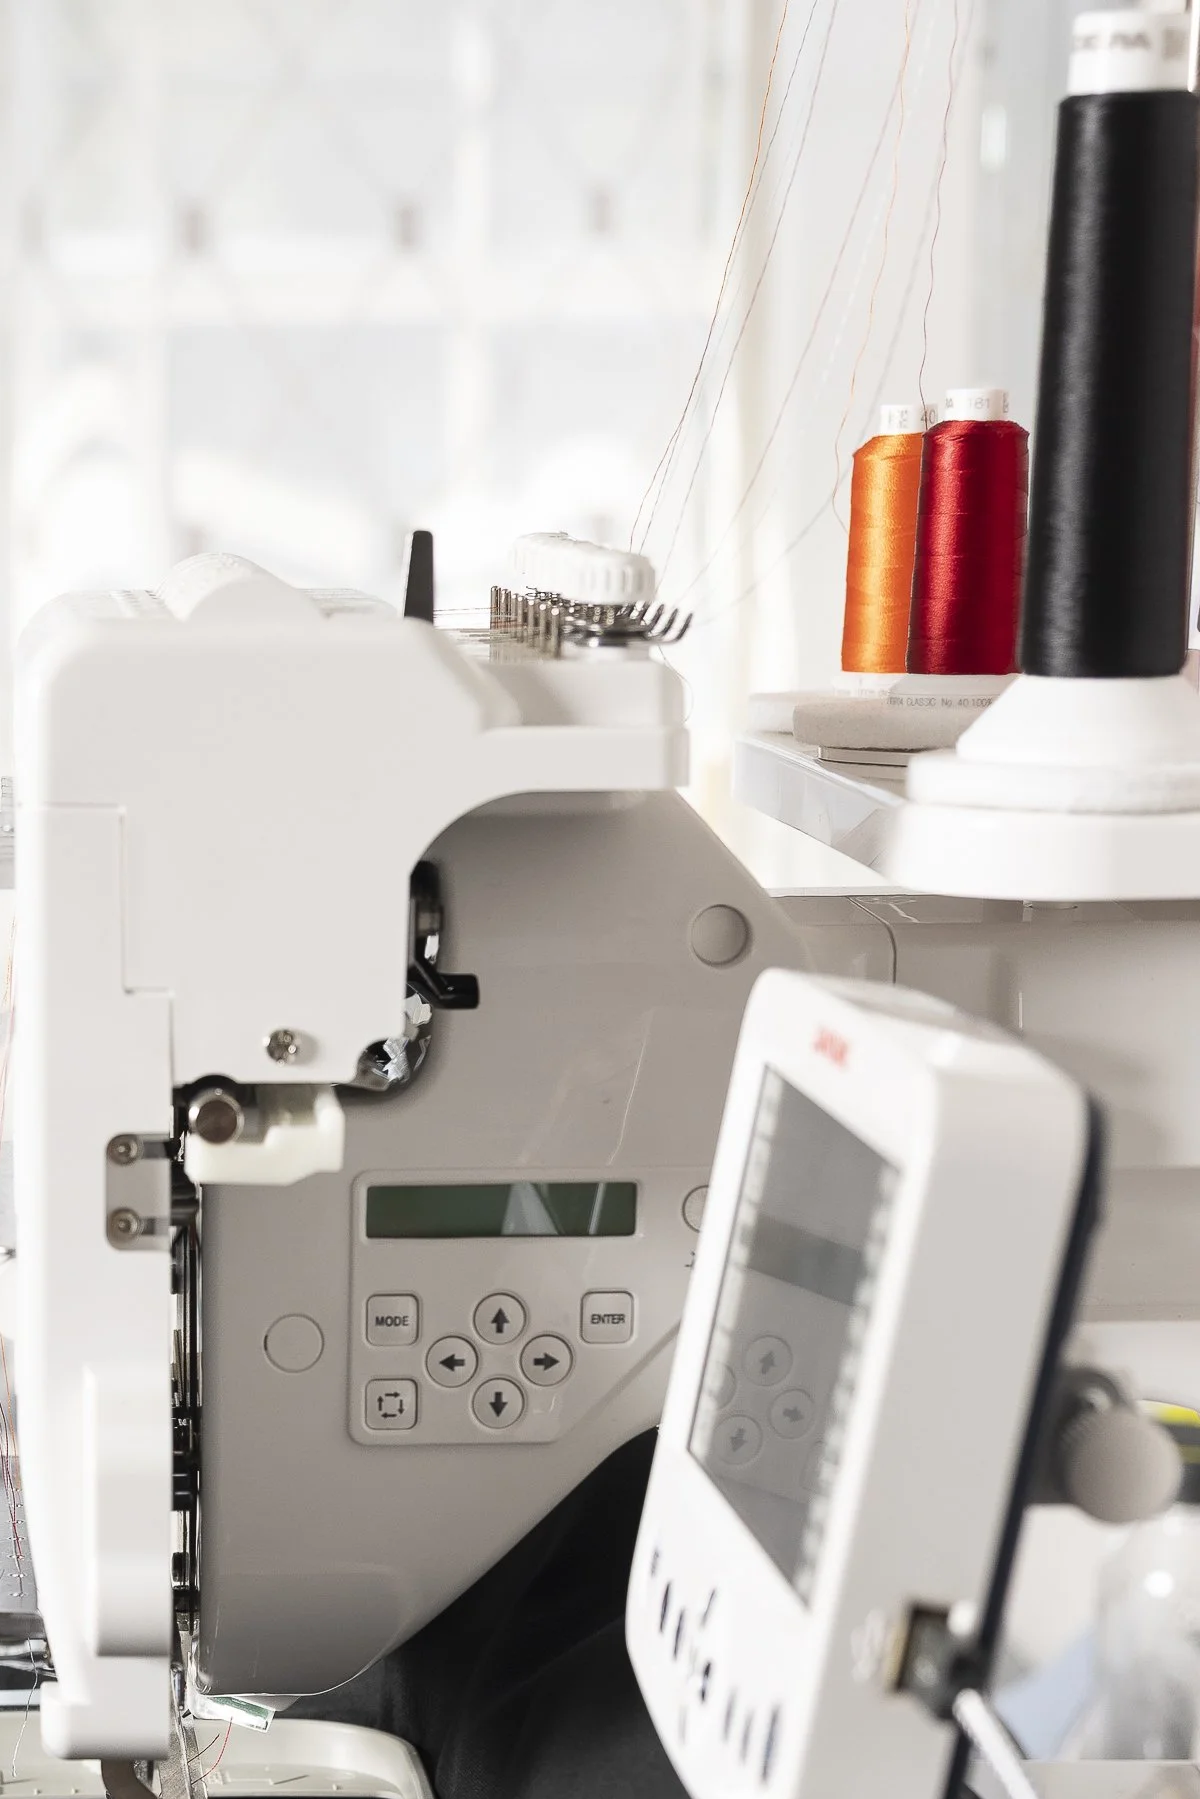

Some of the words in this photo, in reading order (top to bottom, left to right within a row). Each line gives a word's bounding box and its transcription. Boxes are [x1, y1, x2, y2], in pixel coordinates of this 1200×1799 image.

[906, 697, 937, 707] CLASSIC
[957, 698, 970, 708] 40
[375, 1315, 409, 1327] MODE
[590, 1313, 626, 1325] ENTER
